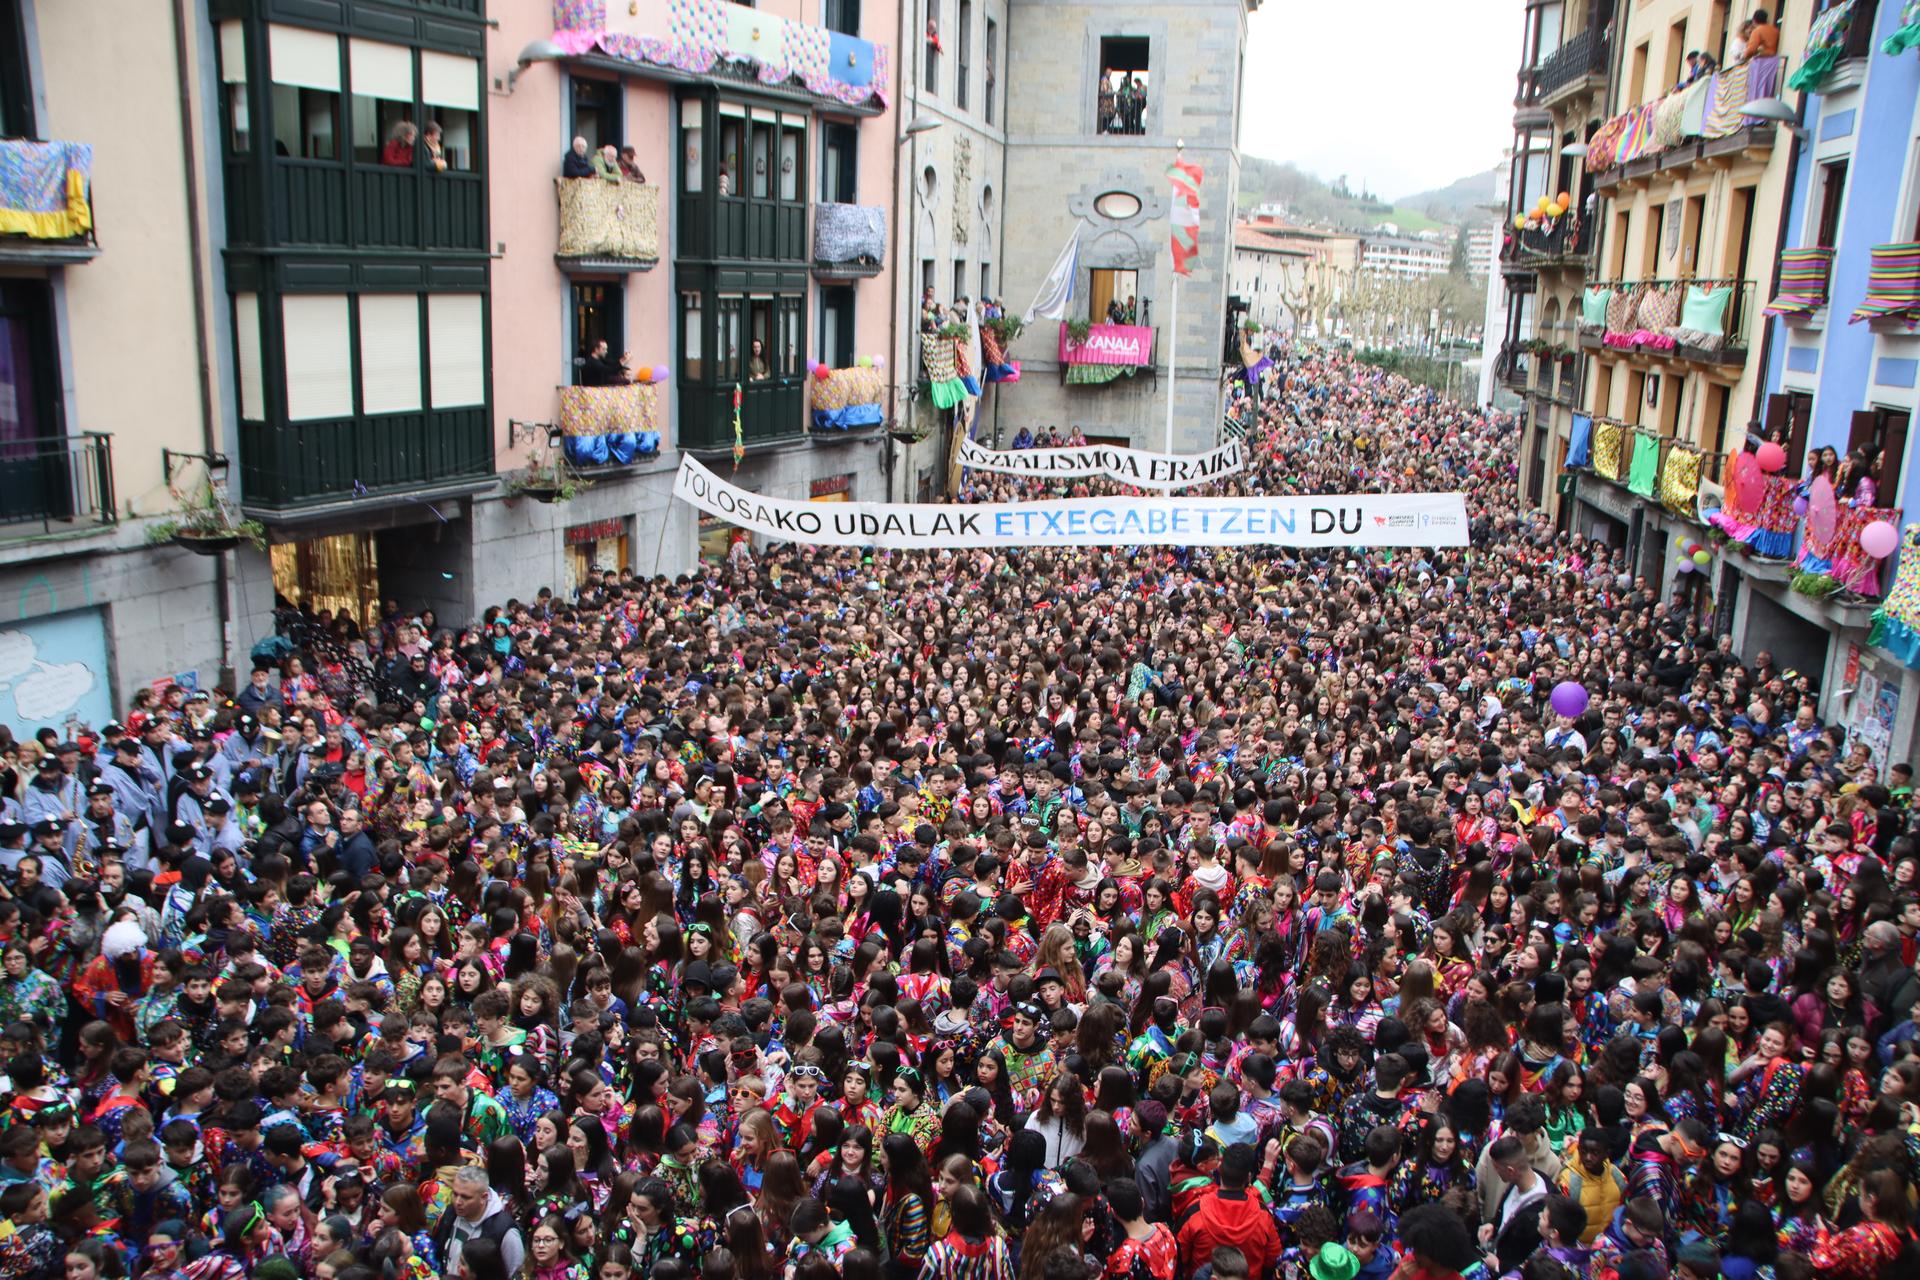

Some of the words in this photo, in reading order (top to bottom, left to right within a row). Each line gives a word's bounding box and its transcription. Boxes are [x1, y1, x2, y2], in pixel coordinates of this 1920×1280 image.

[1086, 335, 1140, 352] KANALA
[959, 440, 1141, 478] SOZIALISMOA
[1149, 443, 1239, 482] ERAIKI
[682, 462, 822, 535] TOLOSAKO
[834, 511, 982, 537] UDALAK
[994, 507, 1296, 536] ETXEGABETZEN
[1310, 507, 1363, 535] DU
